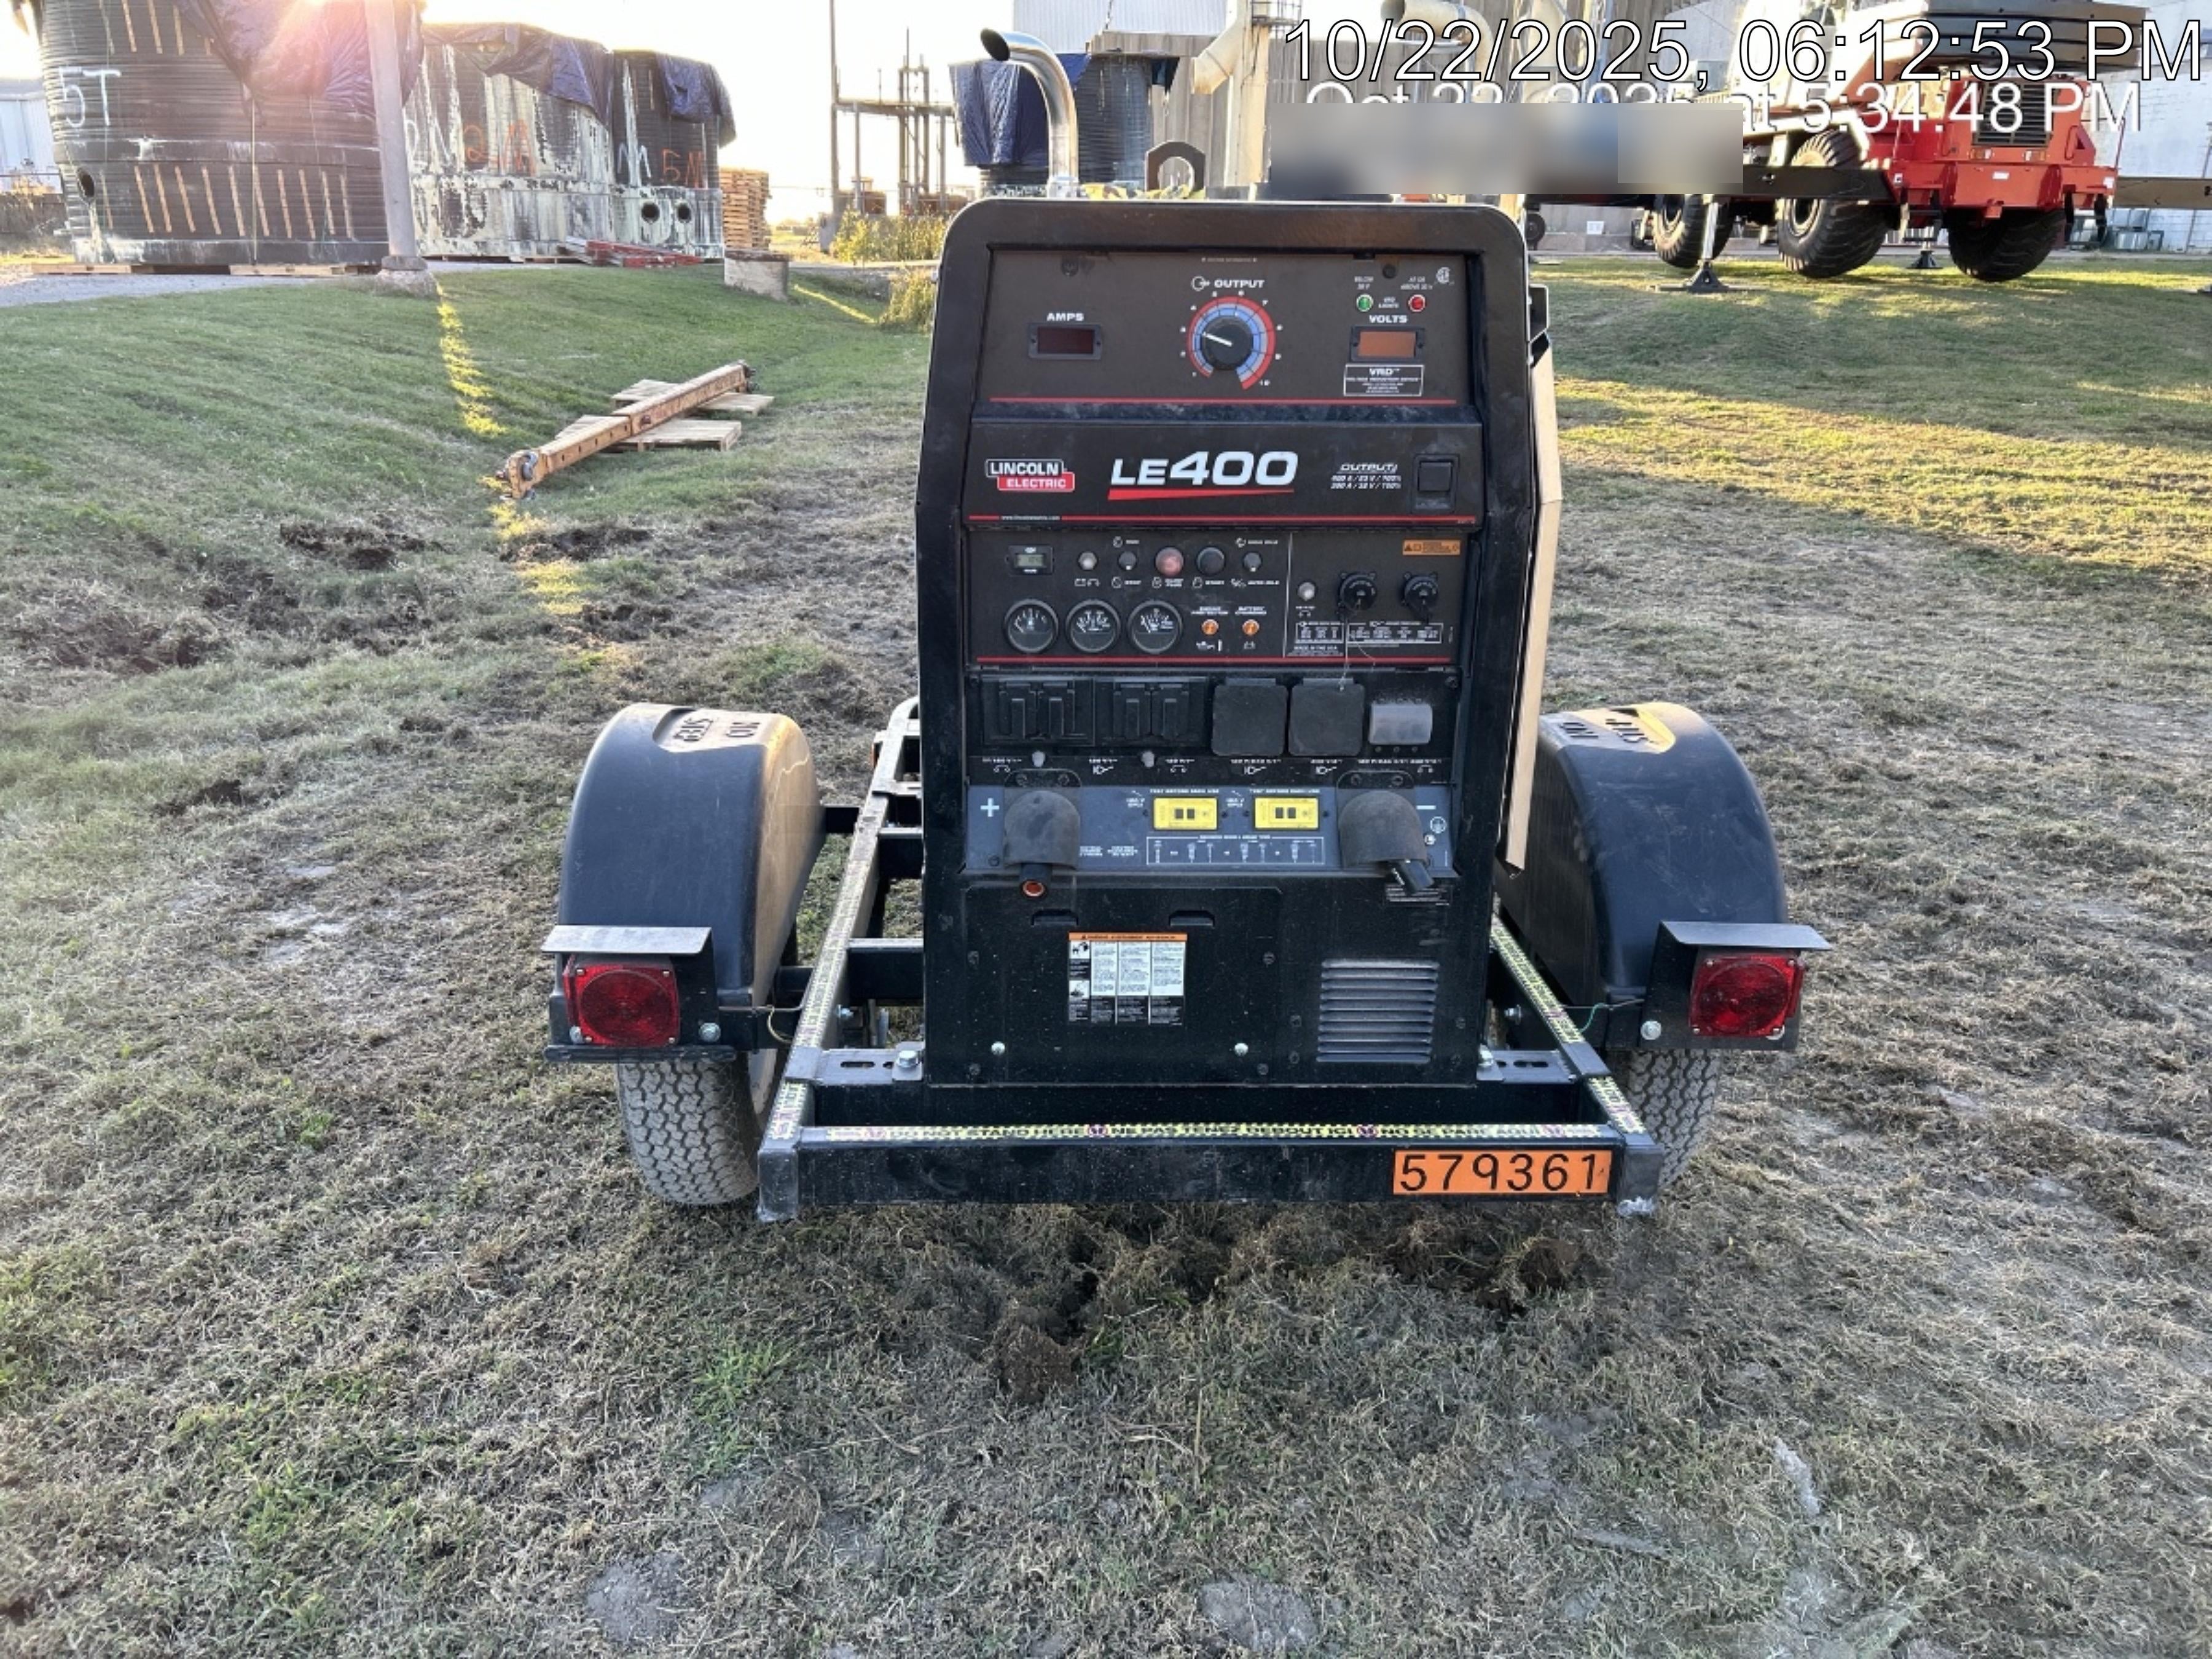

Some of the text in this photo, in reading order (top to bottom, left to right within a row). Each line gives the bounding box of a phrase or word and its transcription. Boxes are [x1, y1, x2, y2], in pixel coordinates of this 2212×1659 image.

[1214, 280, 1265, 288] OUTPUT
[1046, 312, 1084, 321] AMPS
[1369, 315, 1408, 323] VOLTS
[990, 463, 1059, 475] LINCOLN
[1110, 451, 1299, 486] LE400
[1006, 479, 1067, 488] ELECTRIC
[1400, 1153, 1596, 1191] 579361
